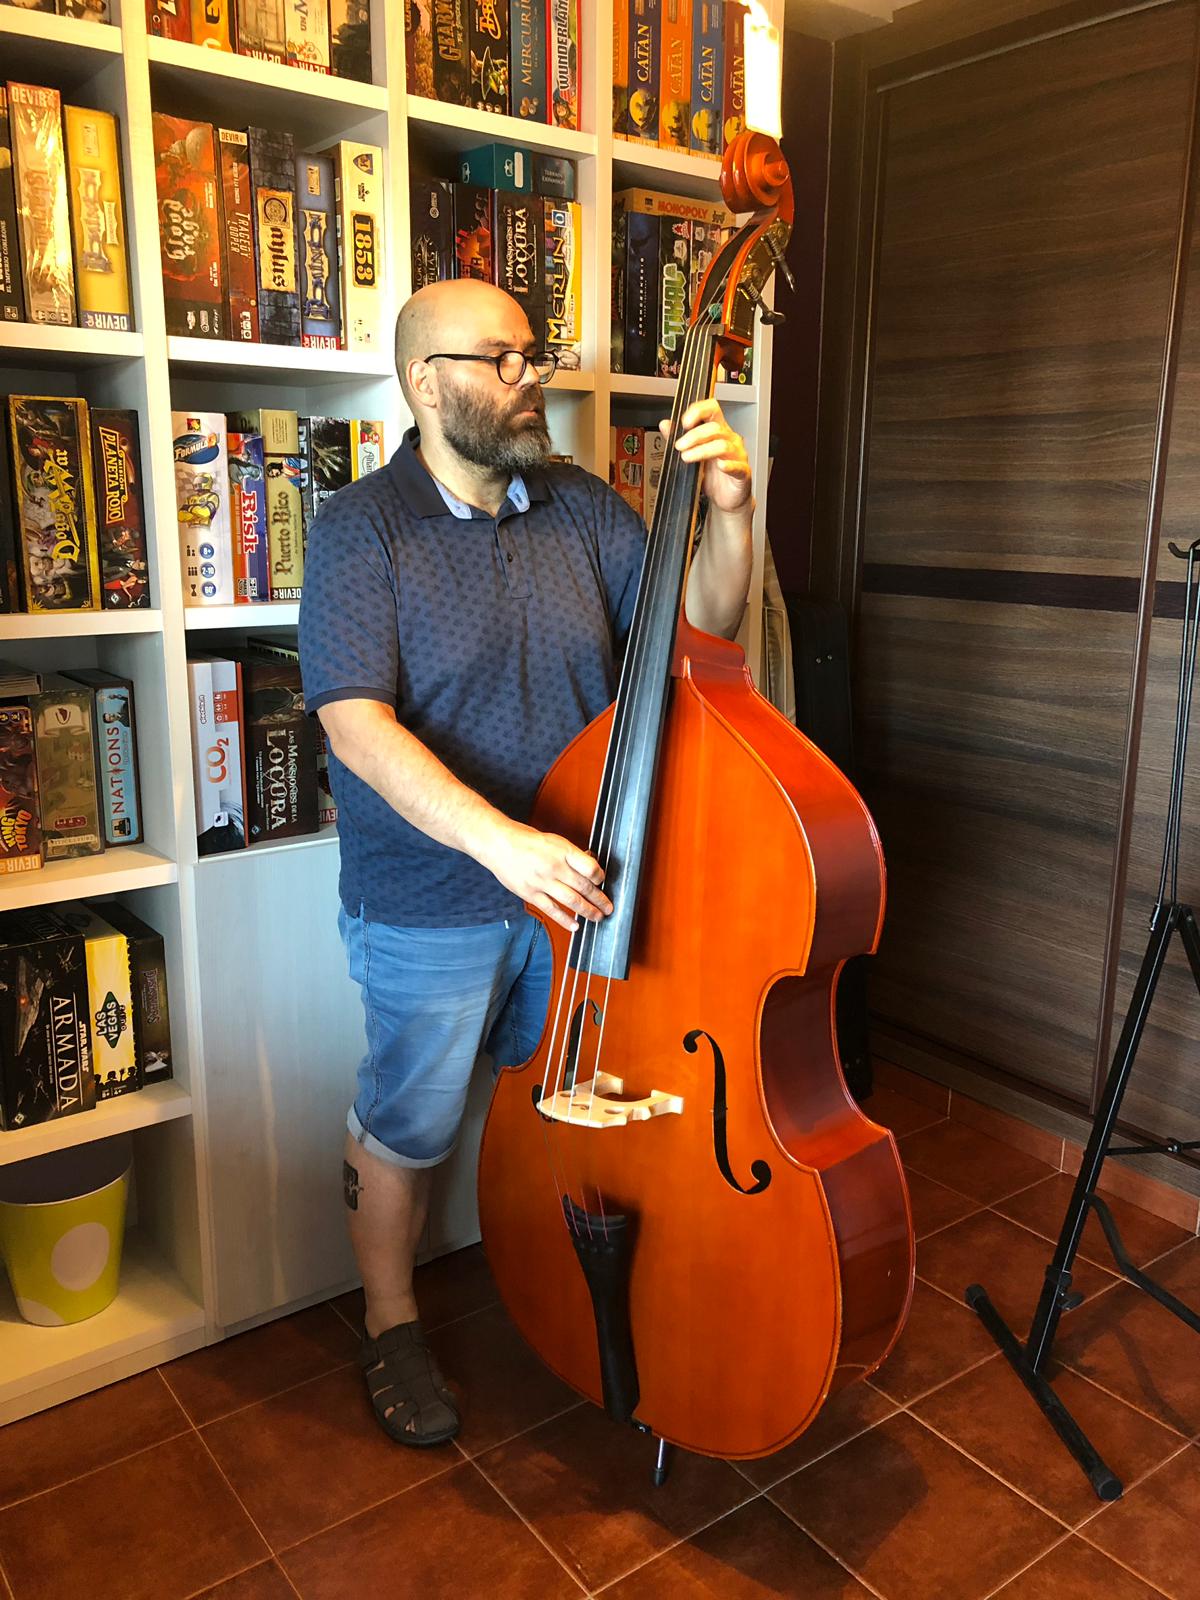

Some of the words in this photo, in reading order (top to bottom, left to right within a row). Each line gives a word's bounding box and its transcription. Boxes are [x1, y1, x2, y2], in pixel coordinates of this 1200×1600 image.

[557, 0, 569, 90] WUNDERLAN
[637, 23, 649, 82] CATAN
[671, 38, 682, 94] CATAN
[701, 46, 713, 102] CATAN
[733, 55, 744, 110] CATAN
[11, 86, 47, 107] DEVIR
[221, 131, 240, 142] DEVIR
[658, 200, 709, 218] MONOPOLY
[227, 220, 240, 254] LOOPER
[235, 212, 251, 259] TRAGEDY
[354, 218, 374, 281] 1853
[513, 207, 529, 293] LOCURA
[303, 212, 330, 320] DOMINION
[547, 236, 573, 346] MERLIN
[663, 271, 687, 335] TIKAL
[95, 313, 128, 331] DEVIR
[310, 336, 337, 351] DEVIR
[104, 433, 118, 488] PLANETA
[174, 441, 208, 462] FORMULA
[108, 488, 122, 522] ROJO
[243, 491, 259, 553] Risk
[272, 491, 290, 526] Rico
[202, 566, 215, 575] 2-10
[203, 547, 212, 556] 8+
[274, 527, 292, 576] Puerto
[279, 588, 302, 599] DEVIR
[106, 726, 126, 814] NATIONS
[266, 729, 287, 830] LOCURA
[288, 745, 298, 804] MANSIONES
[1, 816, 16, 848] KING
[15, 809, 32, 851] TOKYO
[8, 855, 39, 873] DEVIR
[98, 1012, 107, 1036] LAS
[107, 1001, 118, 1041] VEGAS
[53, 996, 80, 1111] ARMADA
[81, 1047, 89, 1073] WARS
